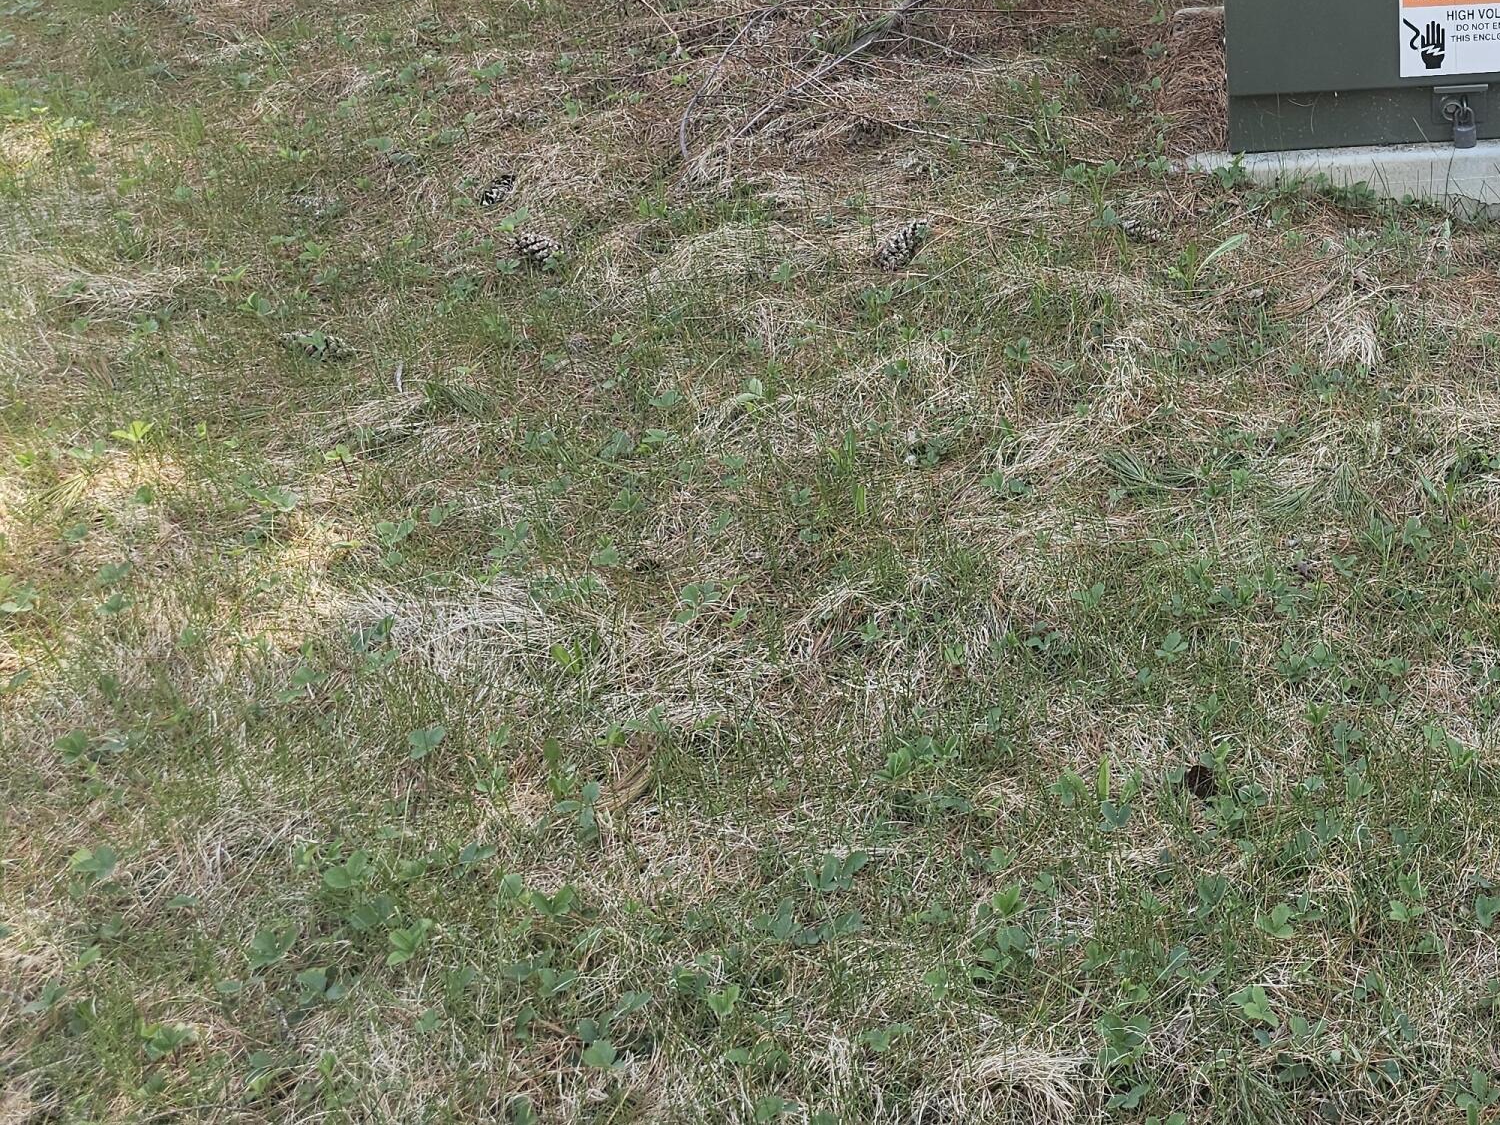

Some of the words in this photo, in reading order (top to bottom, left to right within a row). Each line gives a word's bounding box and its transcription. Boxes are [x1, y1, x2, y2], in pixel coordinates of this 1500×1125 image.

[1447, 10, 1475, 21] HIGH
[1456, 24, 1469, 32] DO
[1471, 22, 1489, 31] NOT
[1451, 34, 1471, 42] THIS
